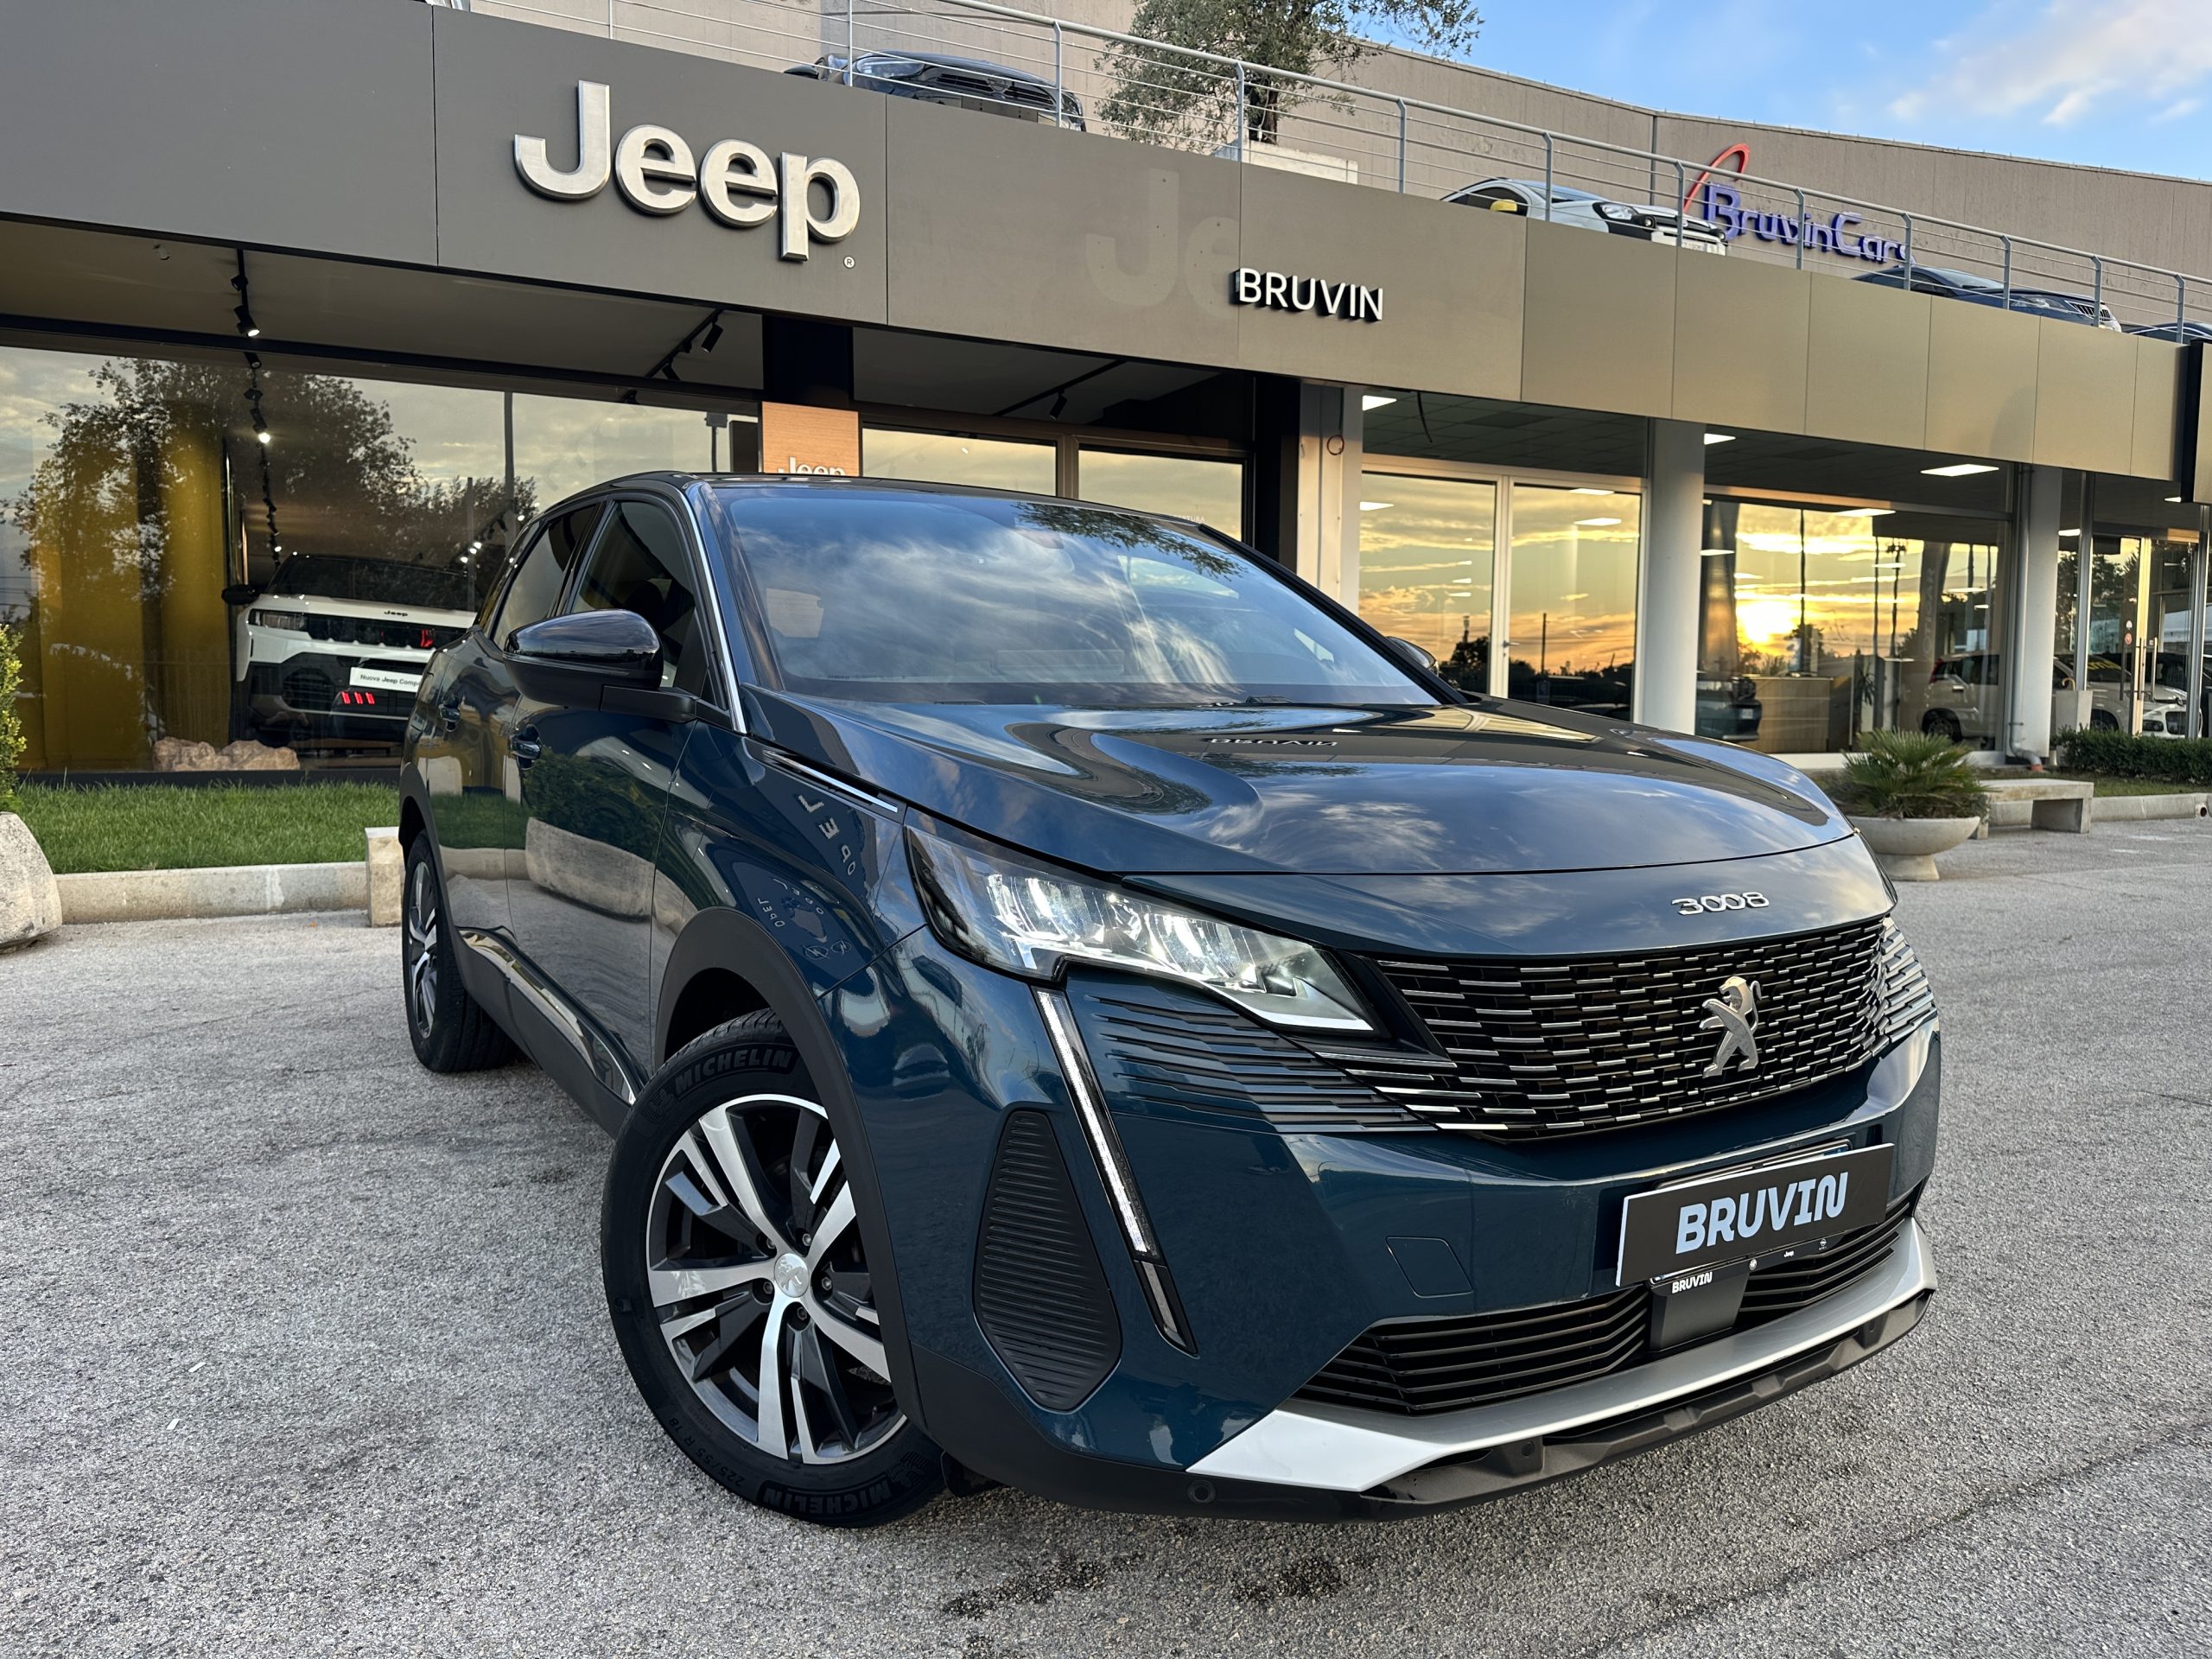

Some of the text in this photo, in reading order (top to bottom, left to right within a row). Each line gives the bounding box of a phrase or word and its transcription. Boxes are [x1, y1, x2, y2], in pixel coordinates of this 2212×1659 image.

[513, 79, 861, 261] Jeep
[1237, 267, 1383, 321] BRUVIN
[1671, 891, 1770, 915] 3008
[674, 1047, 794, 1096] MICHELIN
[1675, 1172, 1849, 1255] BRUVIN
[1671, 1271, 1713, 1294] BRUVIN
[762, 1478, 893, 1516] MICHELIN
